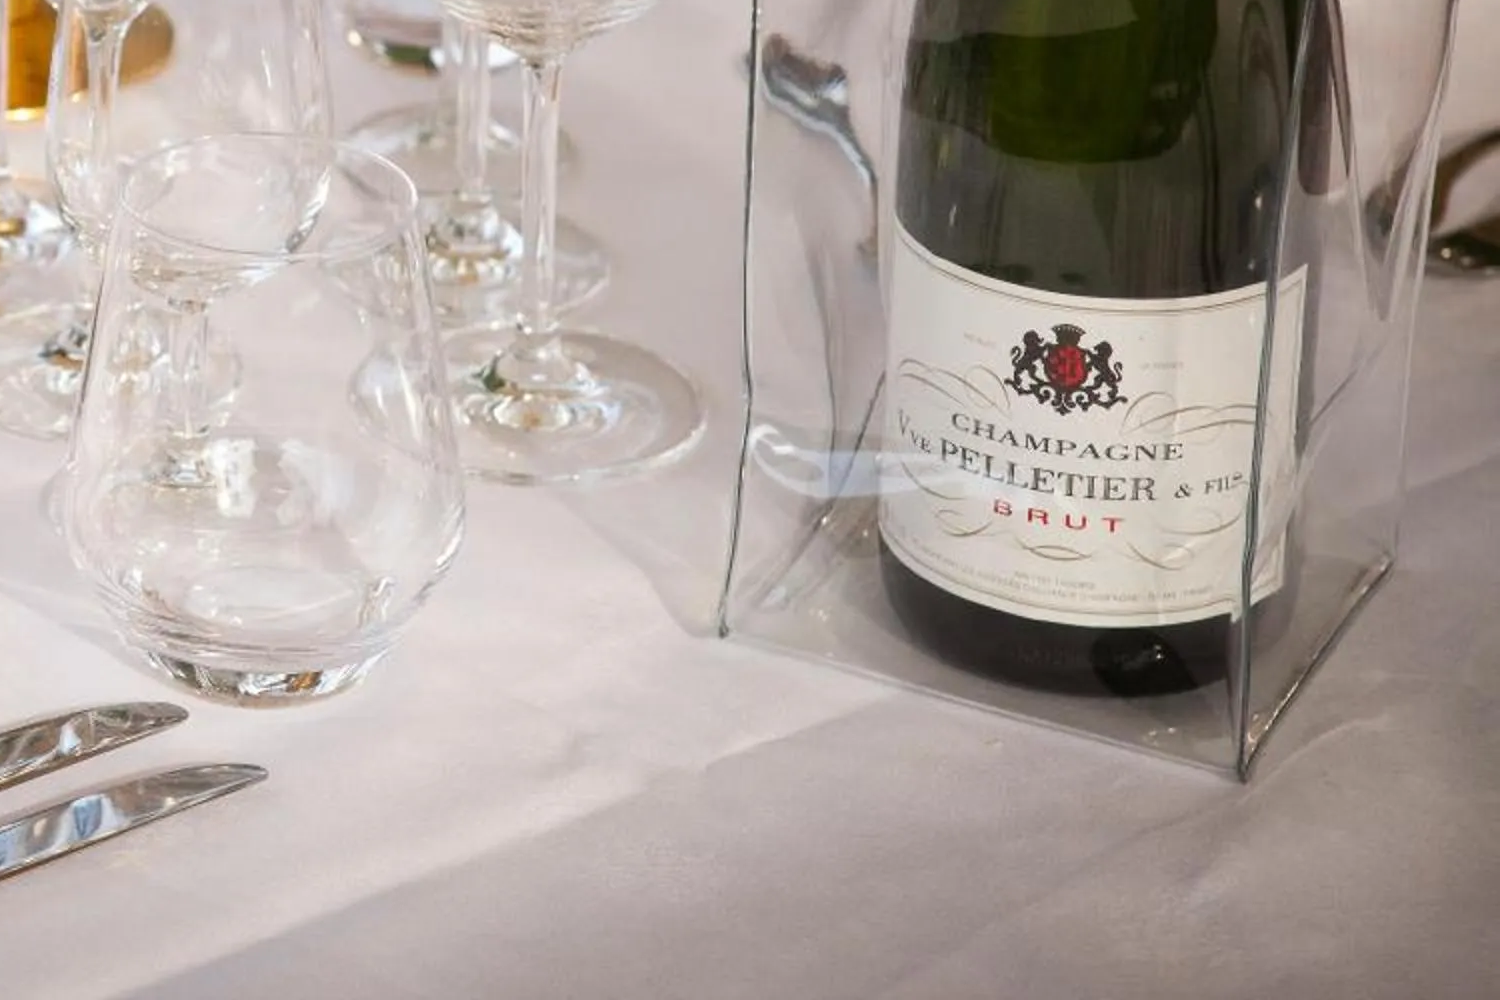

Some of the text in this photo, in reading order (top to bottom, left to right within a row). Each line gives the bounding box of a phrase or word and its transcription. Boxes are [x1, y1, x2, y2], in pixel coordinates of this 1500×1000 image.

[952, 413, 1184, 461] CHAMPAGNE
[940, 437, 1157, 501] PELLETIER
[1173, 482, 1194, 500] &
[993, 499, 1125, 533] BRUT
